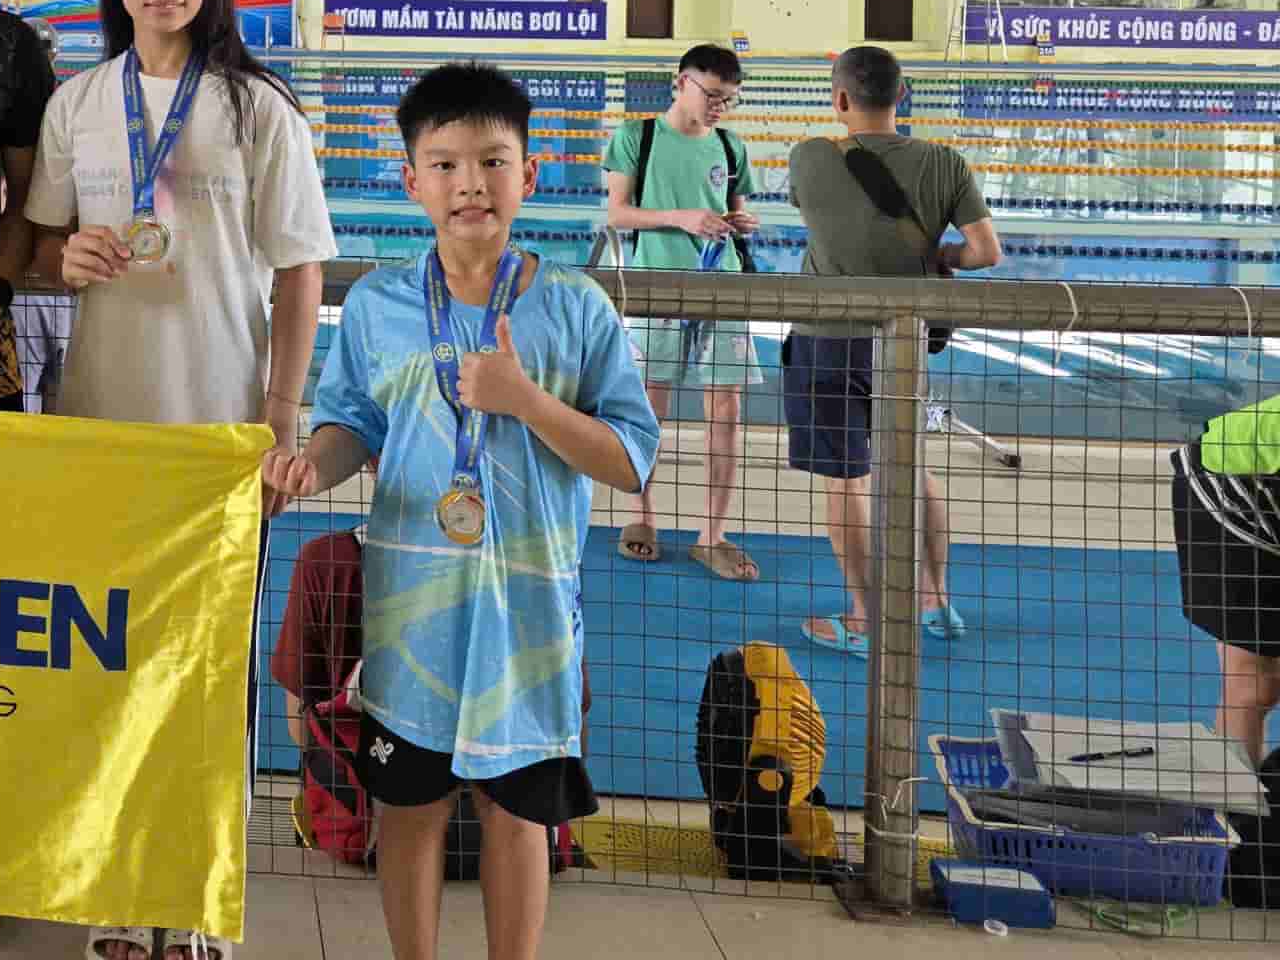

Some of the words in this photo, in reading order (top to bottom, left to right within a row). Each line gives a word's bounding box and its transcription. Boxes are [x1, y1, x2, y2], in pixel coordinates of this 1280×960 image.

[435, 7, 464, 30] TÀI
[470, 7, 523, 31] NĂNG
[528, 11, 561, 31] BƠI
[567, 9, 597, 35] LỘI
[1010, 14, 1051, 38] SỨC
[1057, 13, 1111, 39] KHỎE
[1118, 19, 1174, 44] CỘNG
[1179, 16, 1237, 41] ĐỒNG
